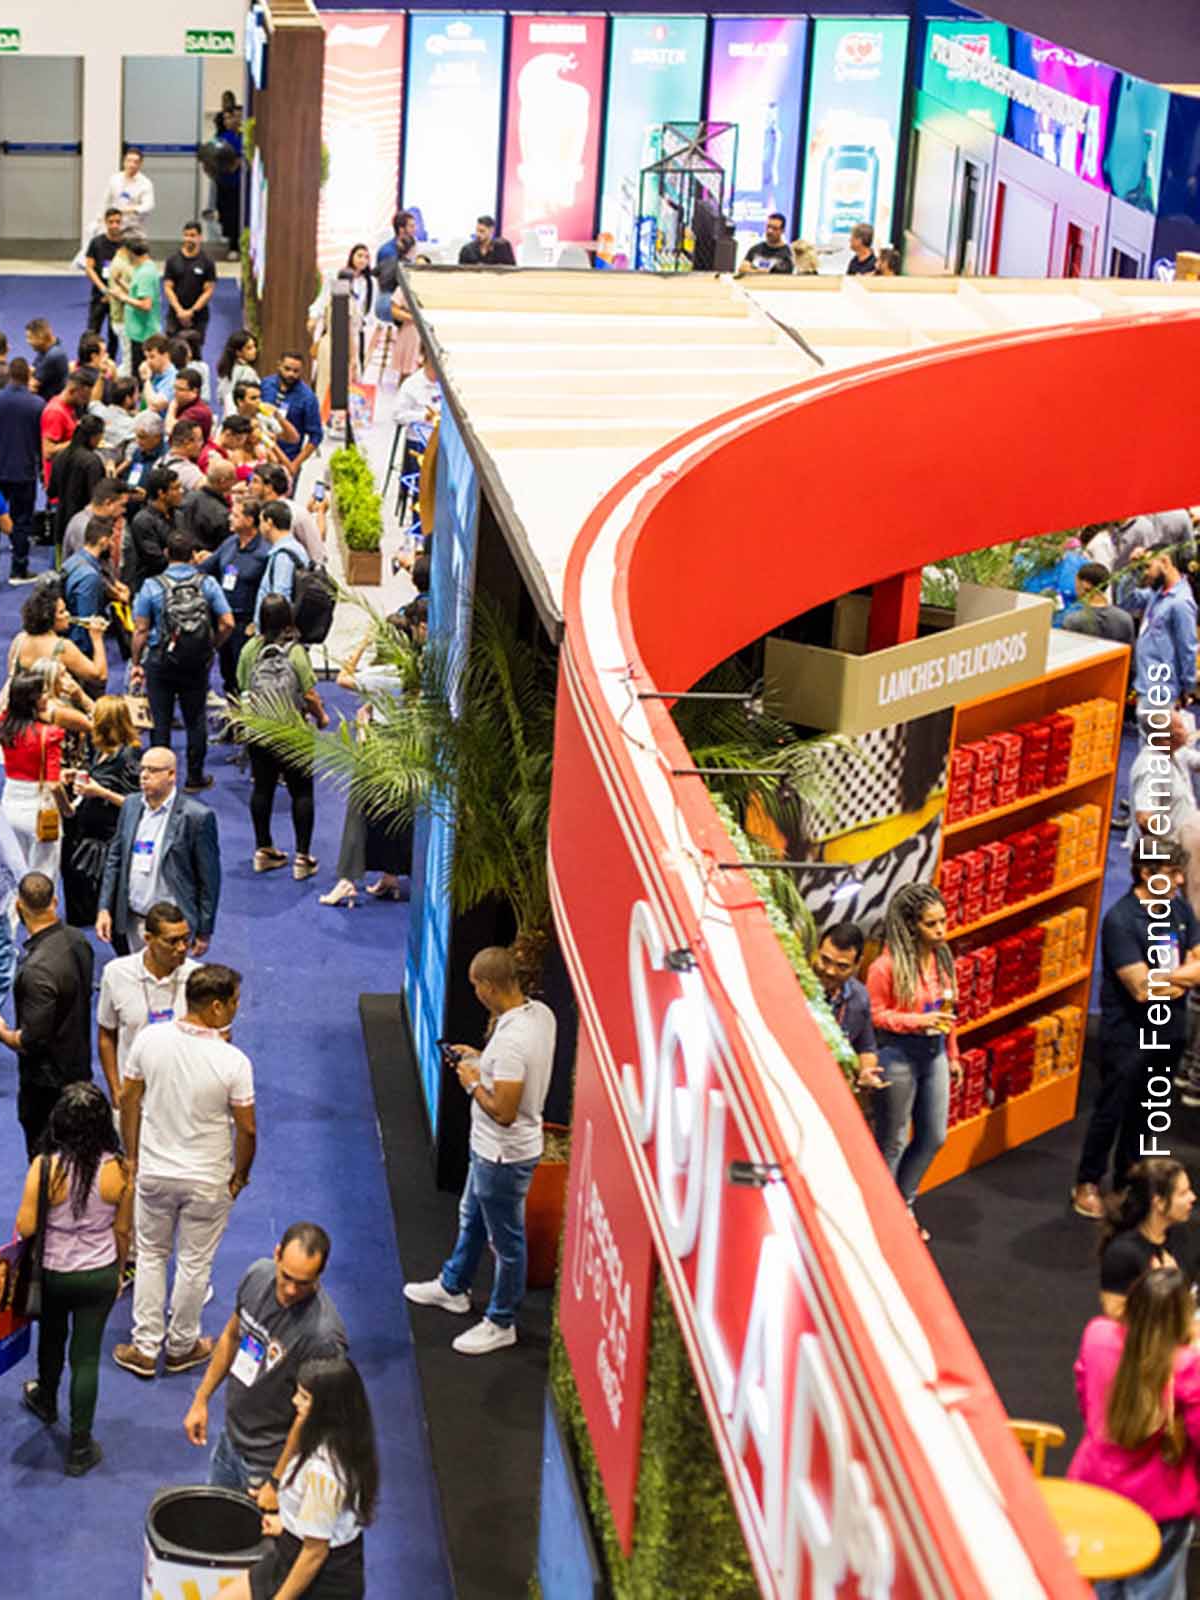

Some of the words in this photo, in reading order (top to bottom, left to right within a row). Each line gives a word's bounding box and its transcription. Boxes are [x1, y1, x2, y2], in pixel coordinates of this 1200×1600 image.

[185, 31, 236, 50] SAÍDA
[878, 656, 945, 705] LANCHES
[946, 631, 1027, 684] DELICIOSOS
